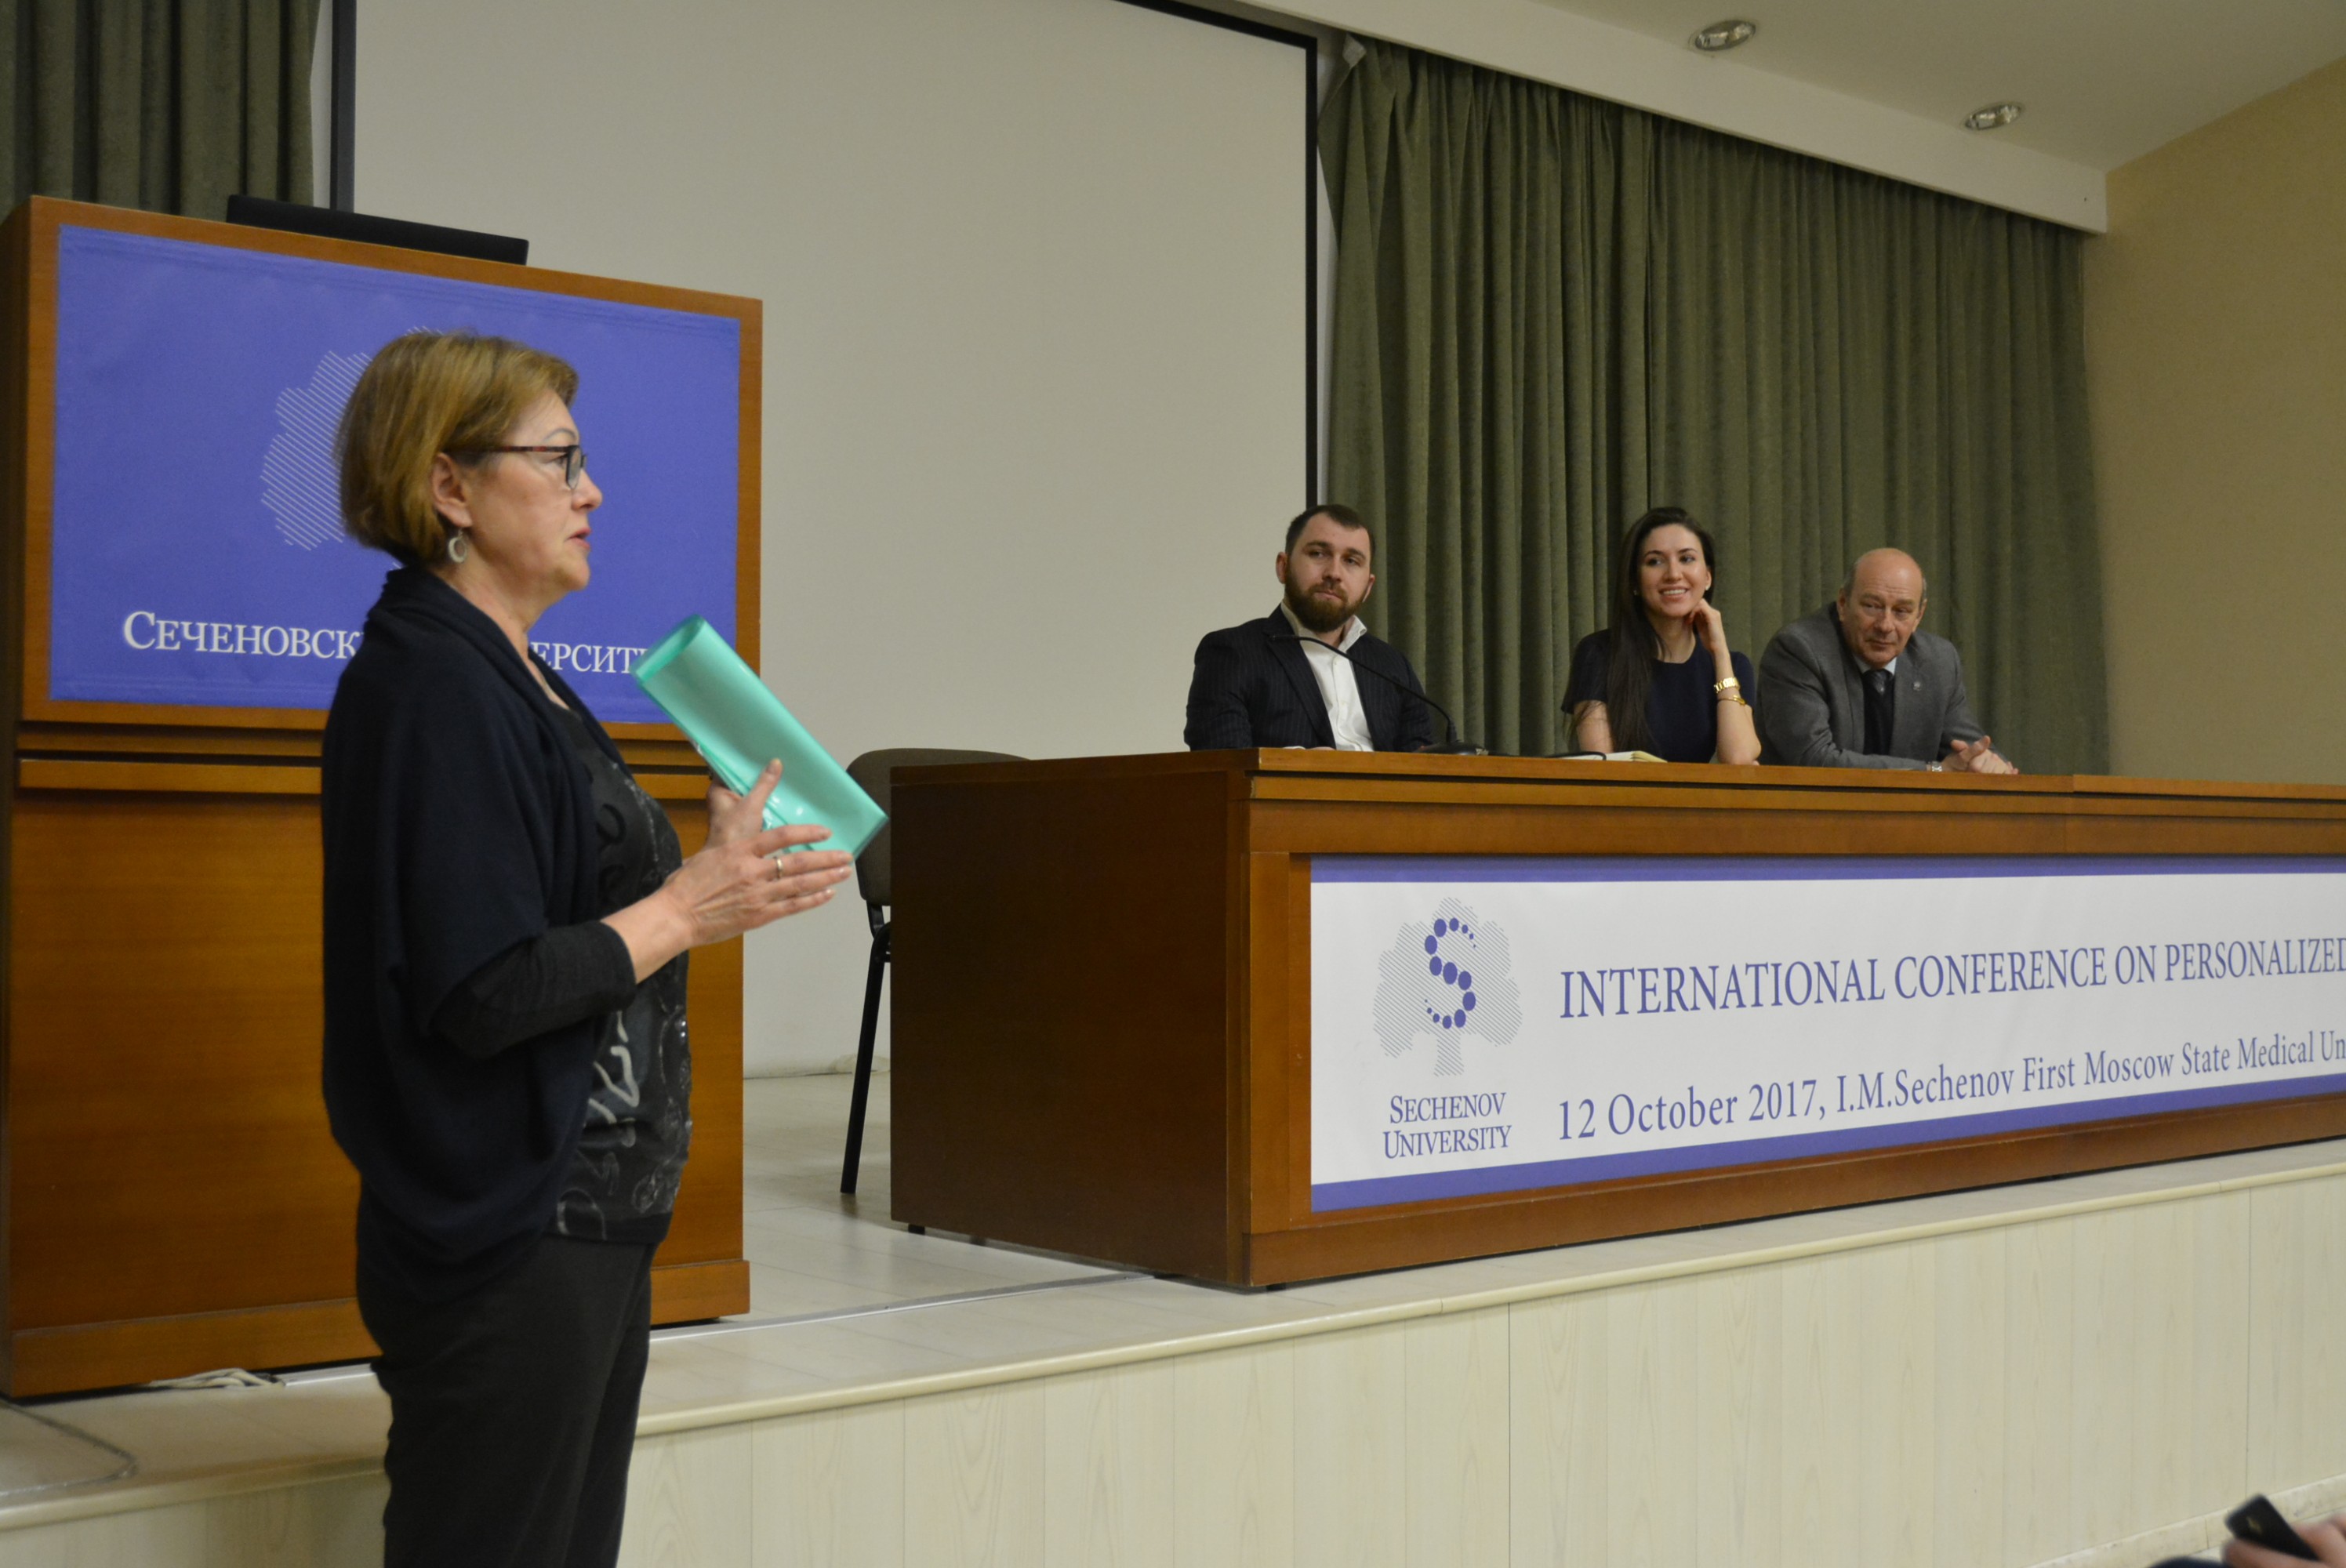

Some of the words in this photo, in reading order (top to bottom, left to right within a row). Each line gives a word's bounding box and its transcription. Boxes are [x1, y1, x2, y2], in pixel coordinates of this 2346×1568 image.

[122, 611, 365, 659] СЕЧЕНОВСК
[1560, 959, 1885, 1018] INTERNATIONAL
[1895, 948, 2110, 999] CONFERENCE
[2115, 946, 2156, 984] ON
[1390, 1092, 1506, 1123] SECHENOV
[1560, 1099, 1596, 1140] 12
[1608, 1086, 1738, 1134] October
[1749, 1080, 1825, 1121] 2017,
[2023, 1058, 2075, 1092] First
[2084, 1051, 2174, 1085] Moscow
[2182, 1042, 2230, 1075] State
[2237, 1030, 2314, 1069] Medical
[1383, 1125, 1512, 1159] UNIVERSITY
